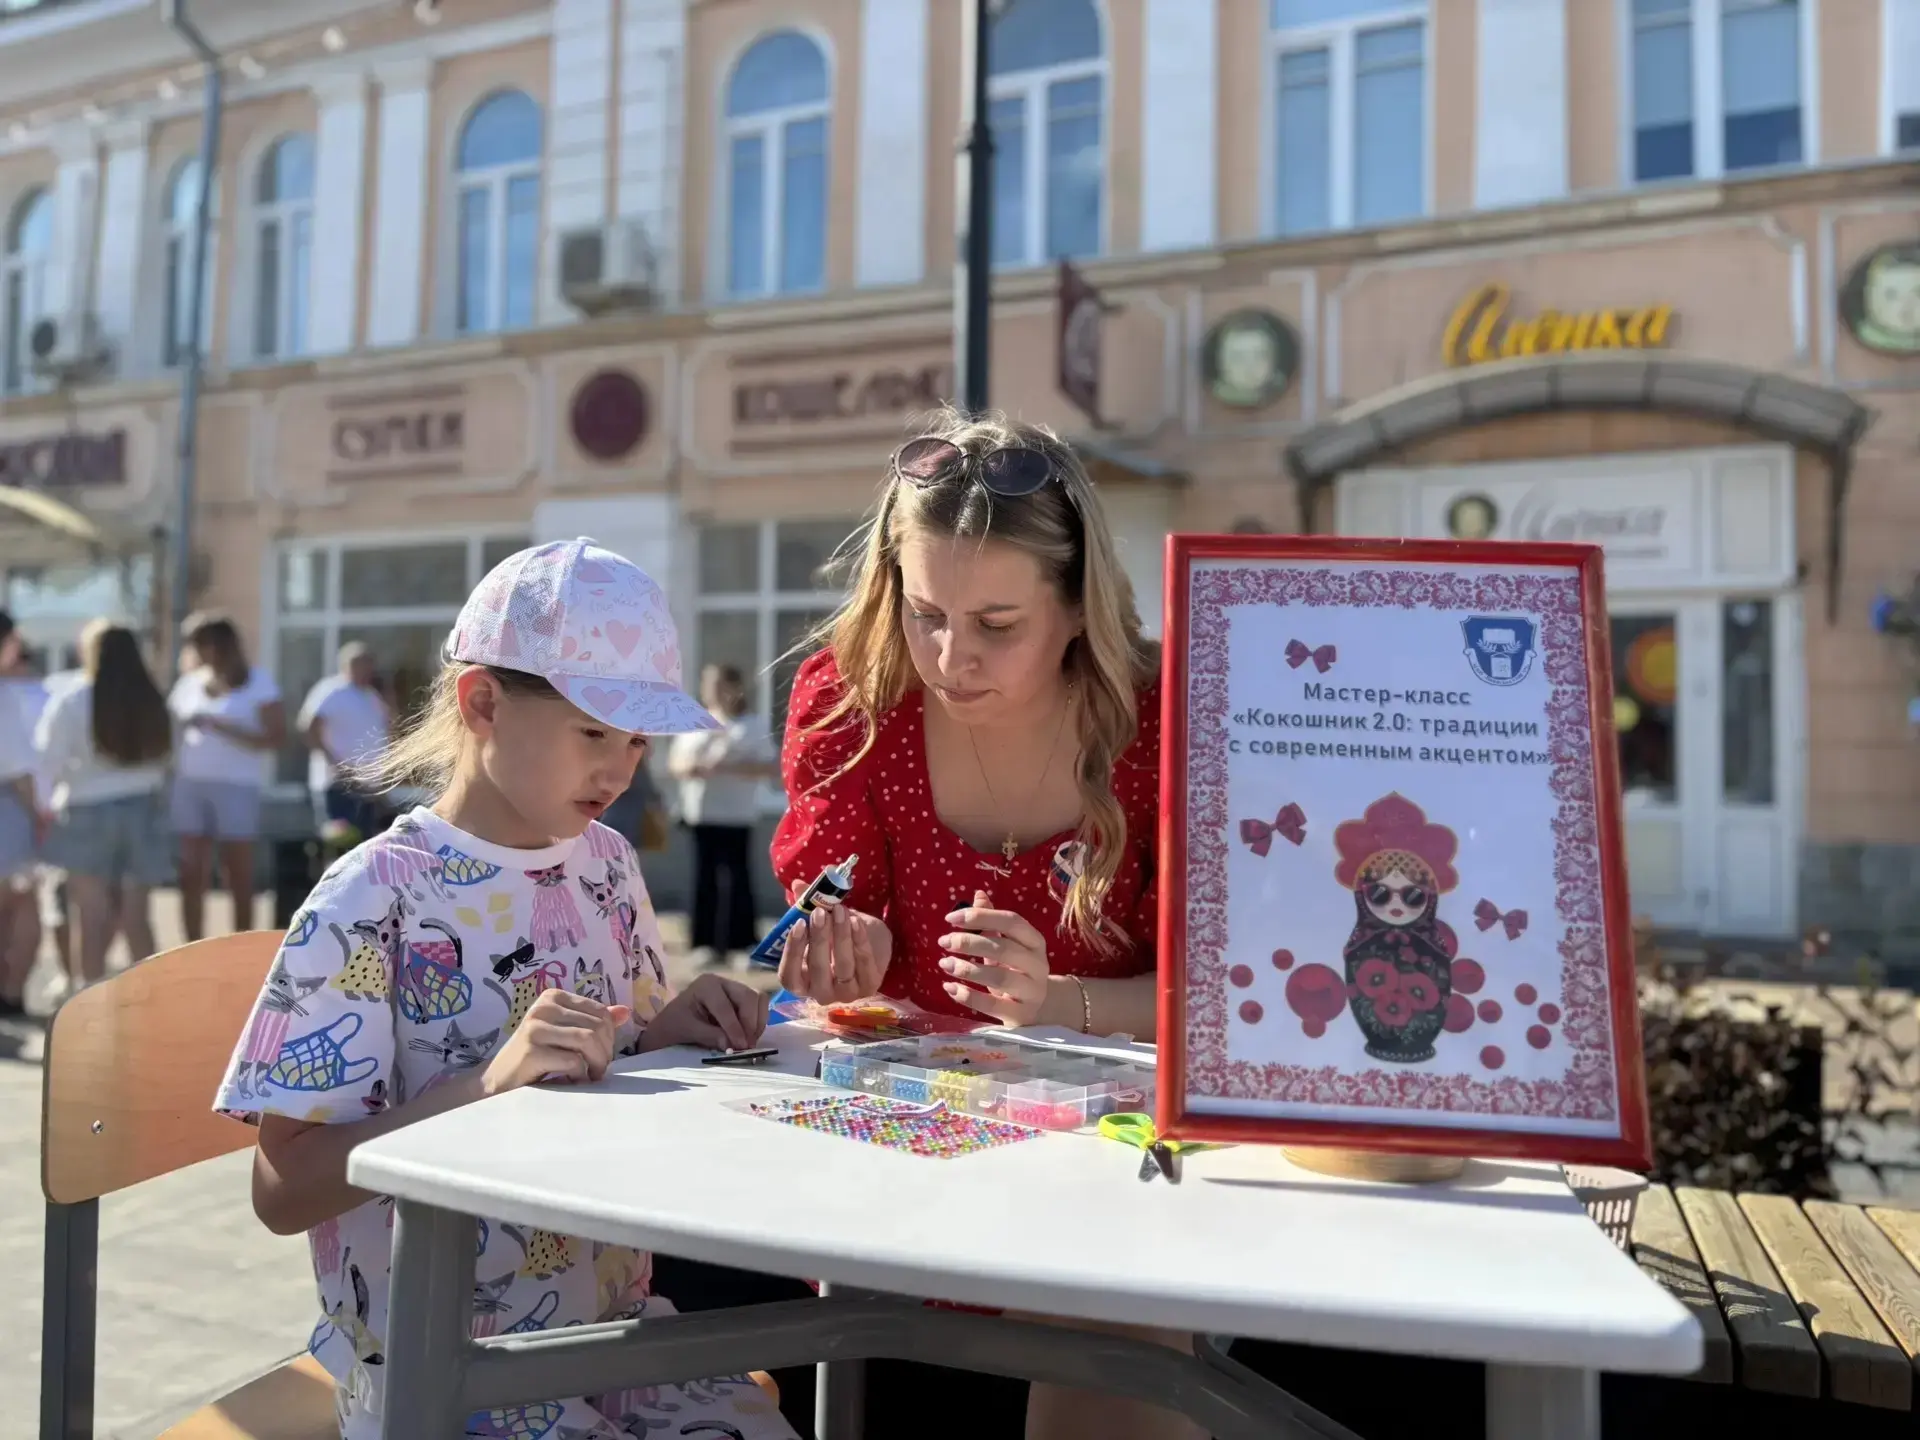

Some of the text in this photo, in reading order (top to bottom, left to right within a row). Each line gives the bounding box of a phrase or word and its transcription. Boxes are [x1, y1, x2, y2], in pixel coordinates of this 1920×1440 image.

[1304, 682, 1471, 707] Мастер-класс
[1233, 707, 1538, 738] «Кокошник 2.0: традиции
[1229, 739, 1549, 765] с современным акцентом»
